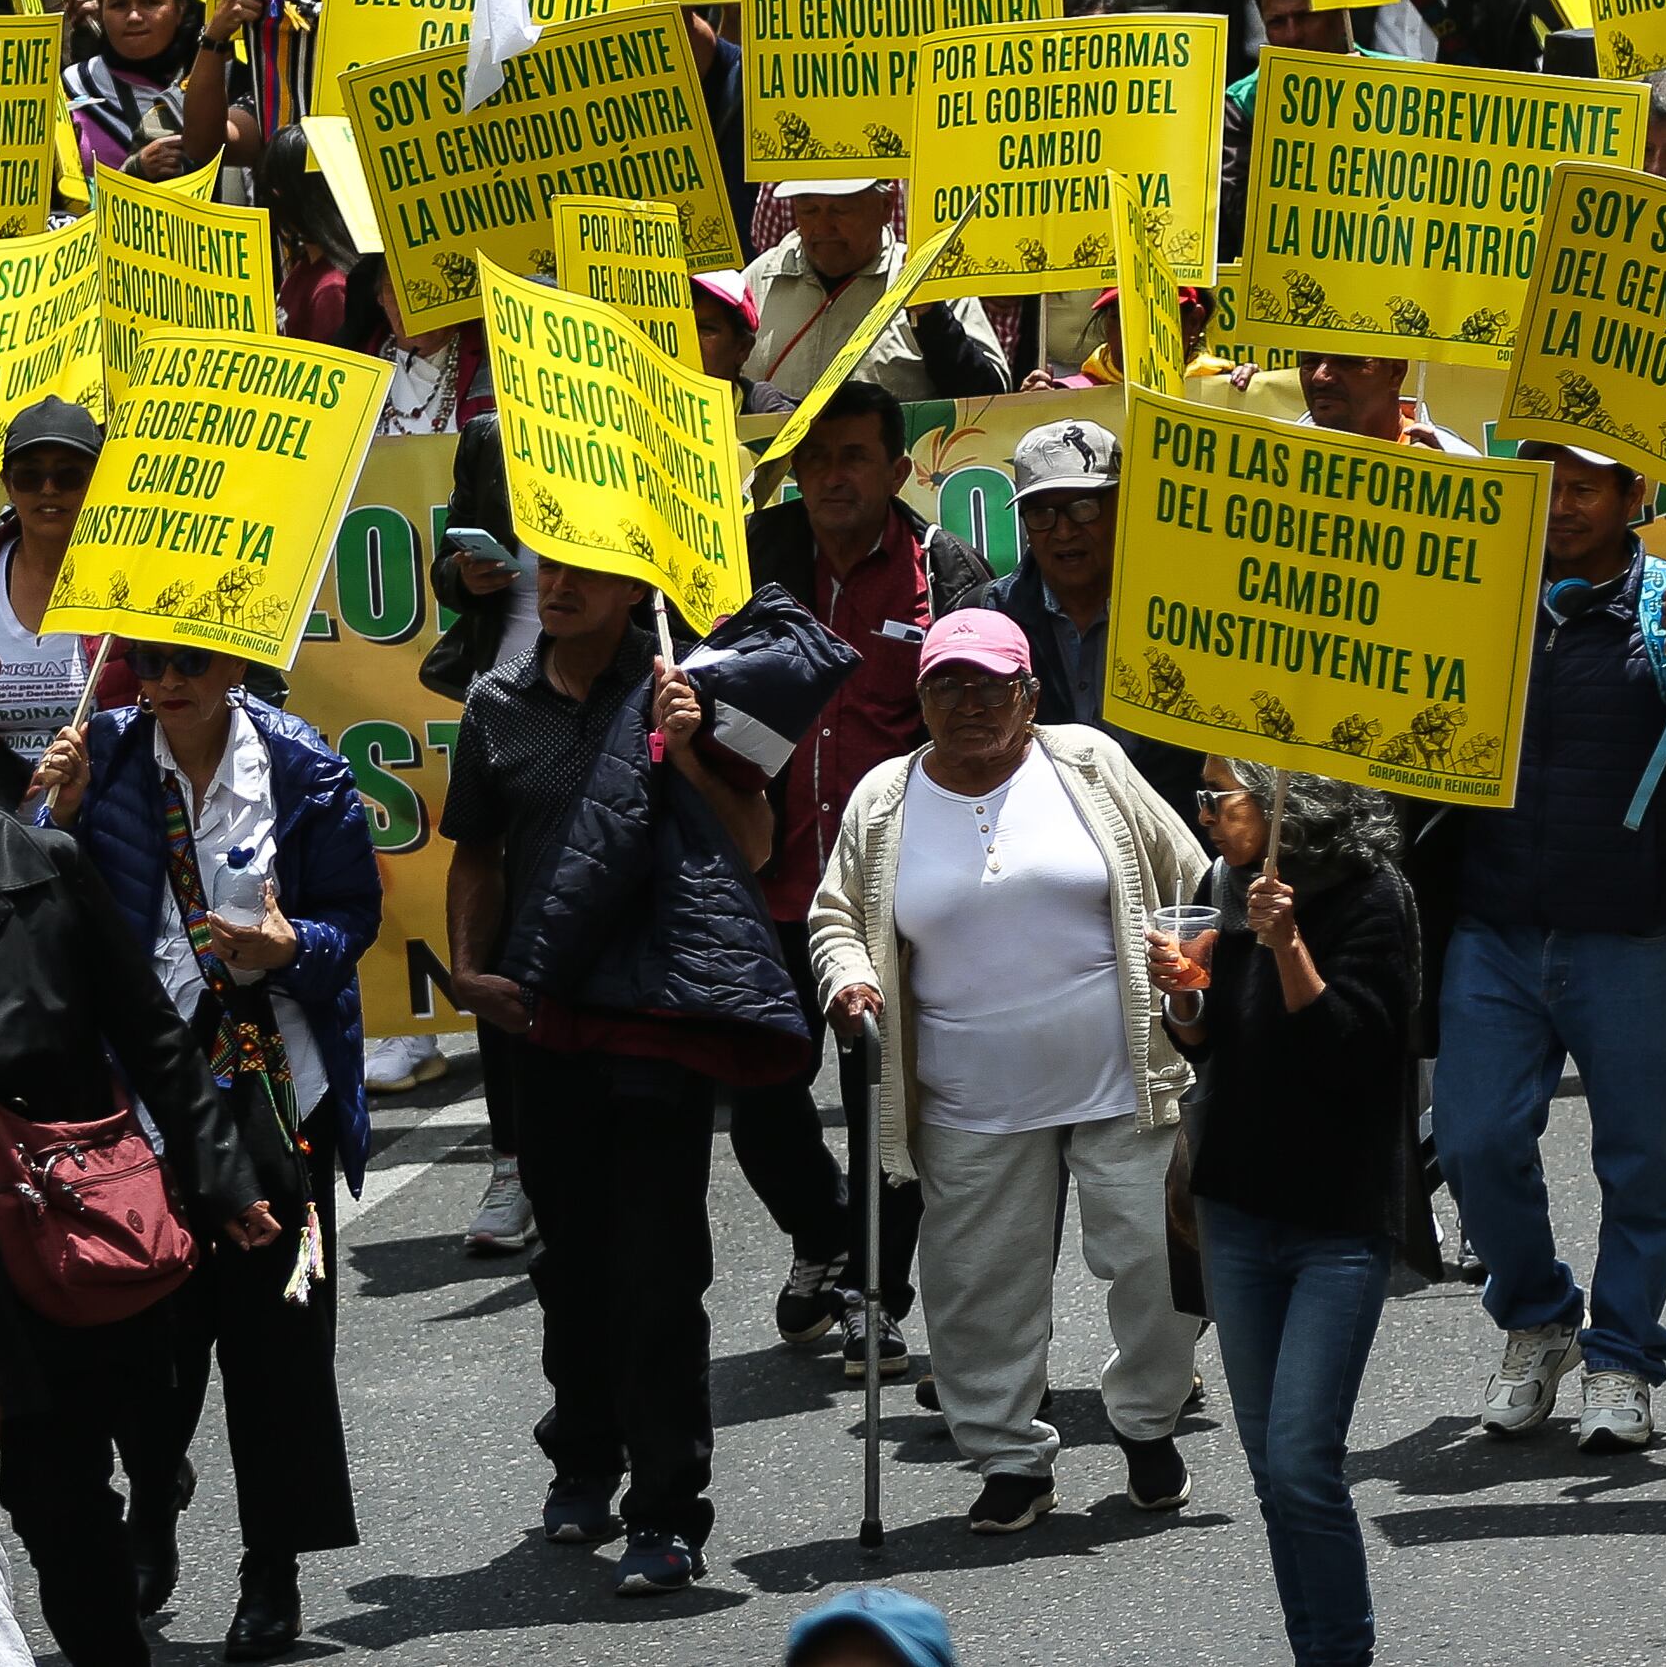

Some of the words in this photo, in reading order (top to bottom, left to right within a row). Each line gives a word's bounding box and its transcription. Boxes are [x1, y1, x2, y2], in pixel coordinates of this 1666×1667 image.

[1571, 187, 1649, 244] SOY
[1551, 247, 1616, 301] DEL
[493, 286, 535, 350] SOY
[544, 310, 714, 445] SOBREVIVIENTE
[1540, 308, 1583, 359] LA
[498, 345, 535, 408] DEL
[537, 367, 655, 449] GENOCIDIO
[657, 432, 724, 509] CONTRA
[1152, 416, 1217, 473] POR
[1228, 433, 1290, 488] LAS
[1300, 449, 1503, 525] REFORMAS
[507, 410, 535, 468] LA
[538, 430, 629, 491] UNIÓN
[631, 451, 727, 569] PATRIÓTICA
[1156, 478, 1213, 535] DEL
[1224, 493, 1405, 571] GOBIERNO
[1415, 532, 1482, 584] DEL
[1237, 556, 1380, 626] CAMBIO
[1146, 595, 1412, 696] CONSTITUYENTE
[1424, 653, 1468, 704] YA
[1368, 763, 1442, 792] CORPORACIÓN
[1444, 776, 1500, 797] REINICIAR
